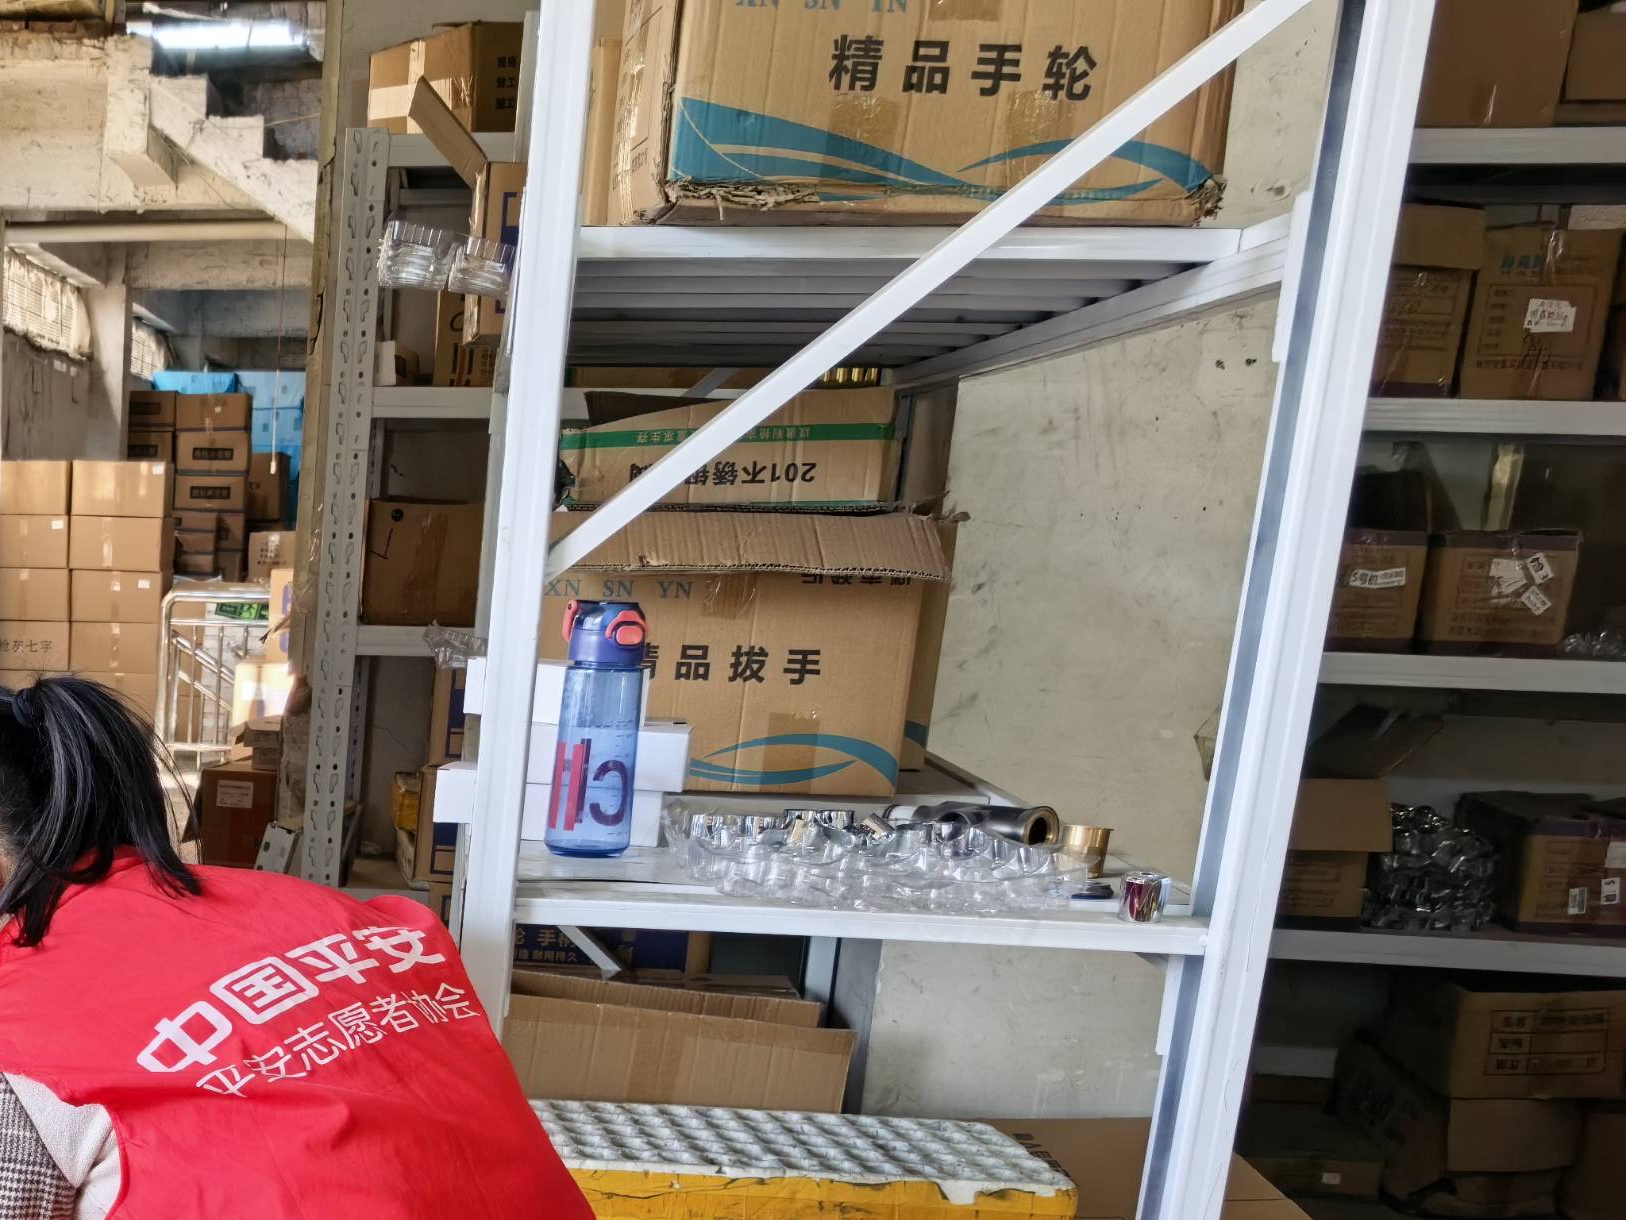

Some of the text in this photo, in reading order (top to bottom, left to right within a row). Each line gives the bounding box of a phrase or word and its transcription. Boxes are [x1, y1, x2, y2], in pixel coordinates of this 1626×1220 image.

[828, 34, 1097, 101] 精品手轮
[602, 580, 633, 598] SN
[659, 581, 694, 599] YN
[136, 926, 446, 1073] 中国平安
[196, 982, 481, 1098] 平安志愿者协会
